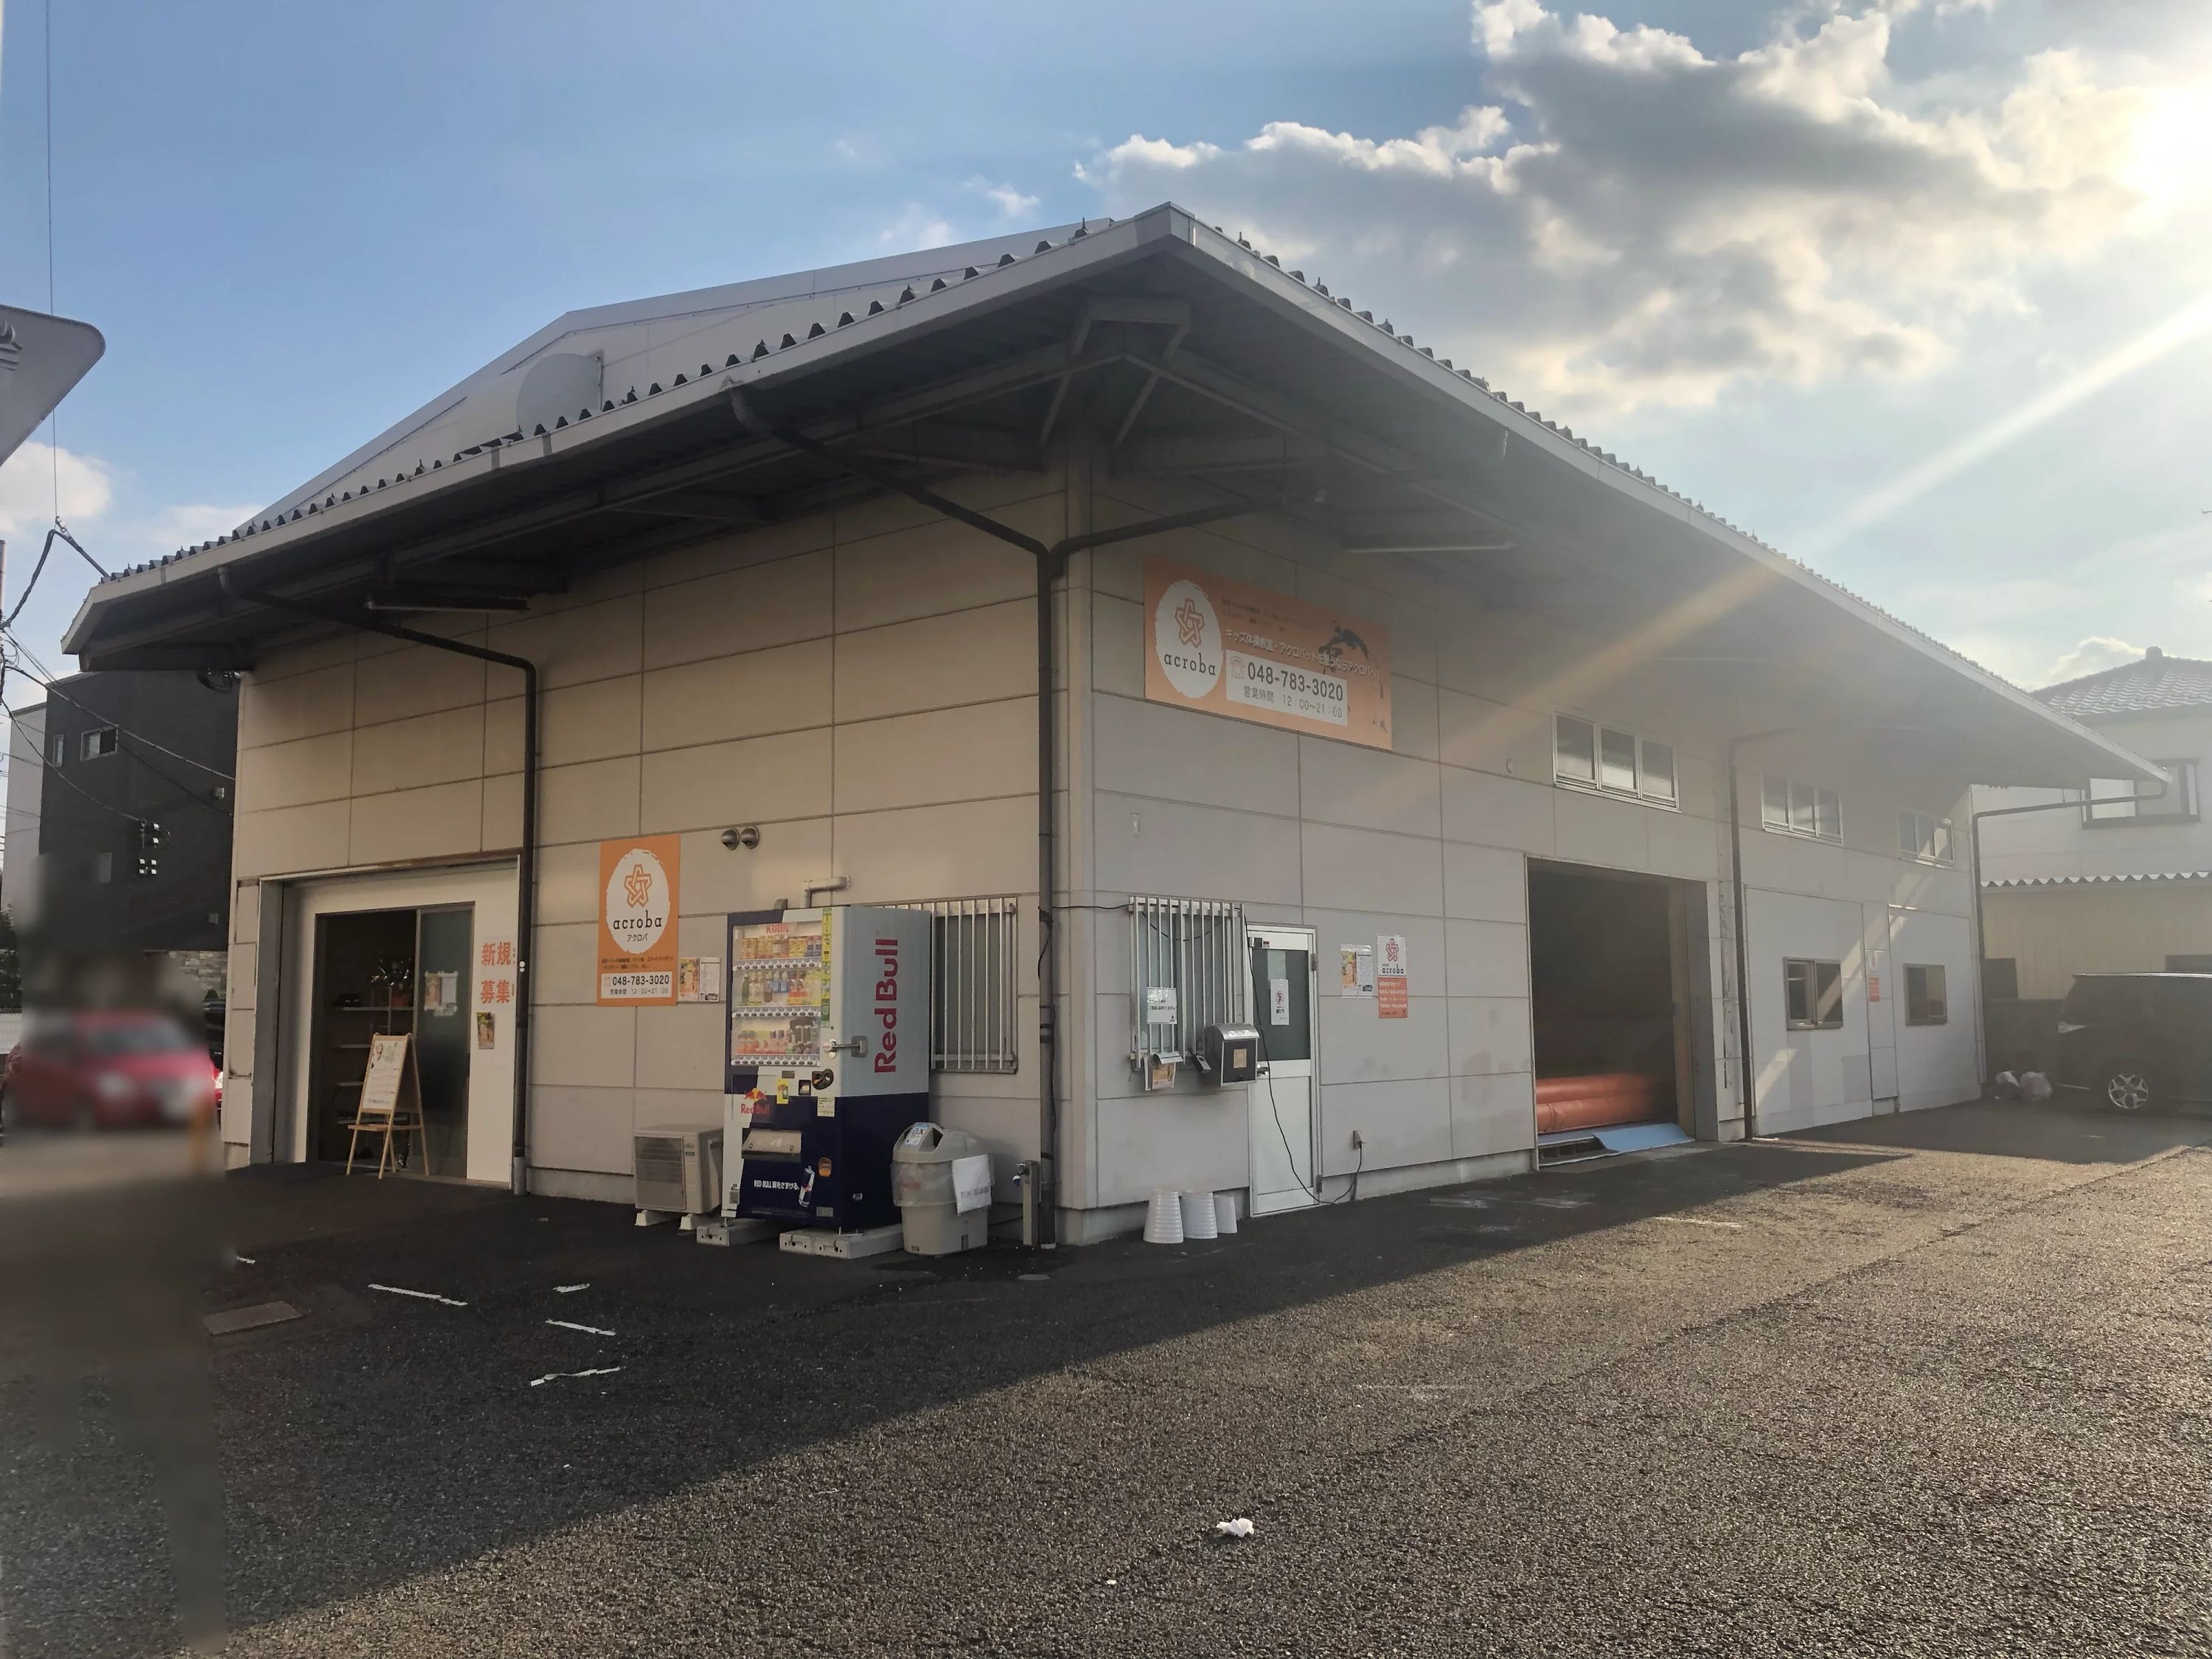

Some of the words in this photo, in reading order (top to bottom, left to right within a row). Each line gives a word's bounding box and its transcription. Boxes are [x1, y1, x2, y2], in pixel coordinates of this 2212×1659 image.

[1164, 653, 1216, 676] acroba
[1248, 661, 1343, 701] 048-783-3020
[1243, 686, 1274, 703] 営業時間
[613, 910, 662, 930] acroba
[766, 924, 789, 933] KIRIN
[627, 933, 648, 942] アクロバ
[481, 942, 515, 966] 新規
[875, 939, 898, 1001] Bull
[1382, 964, 1404, 974] acroba
[613, 975, 669, 986] 048-783-3020
[481, 980, 515, 1004] 募集
[874, 1007, 897, 1073] Red
